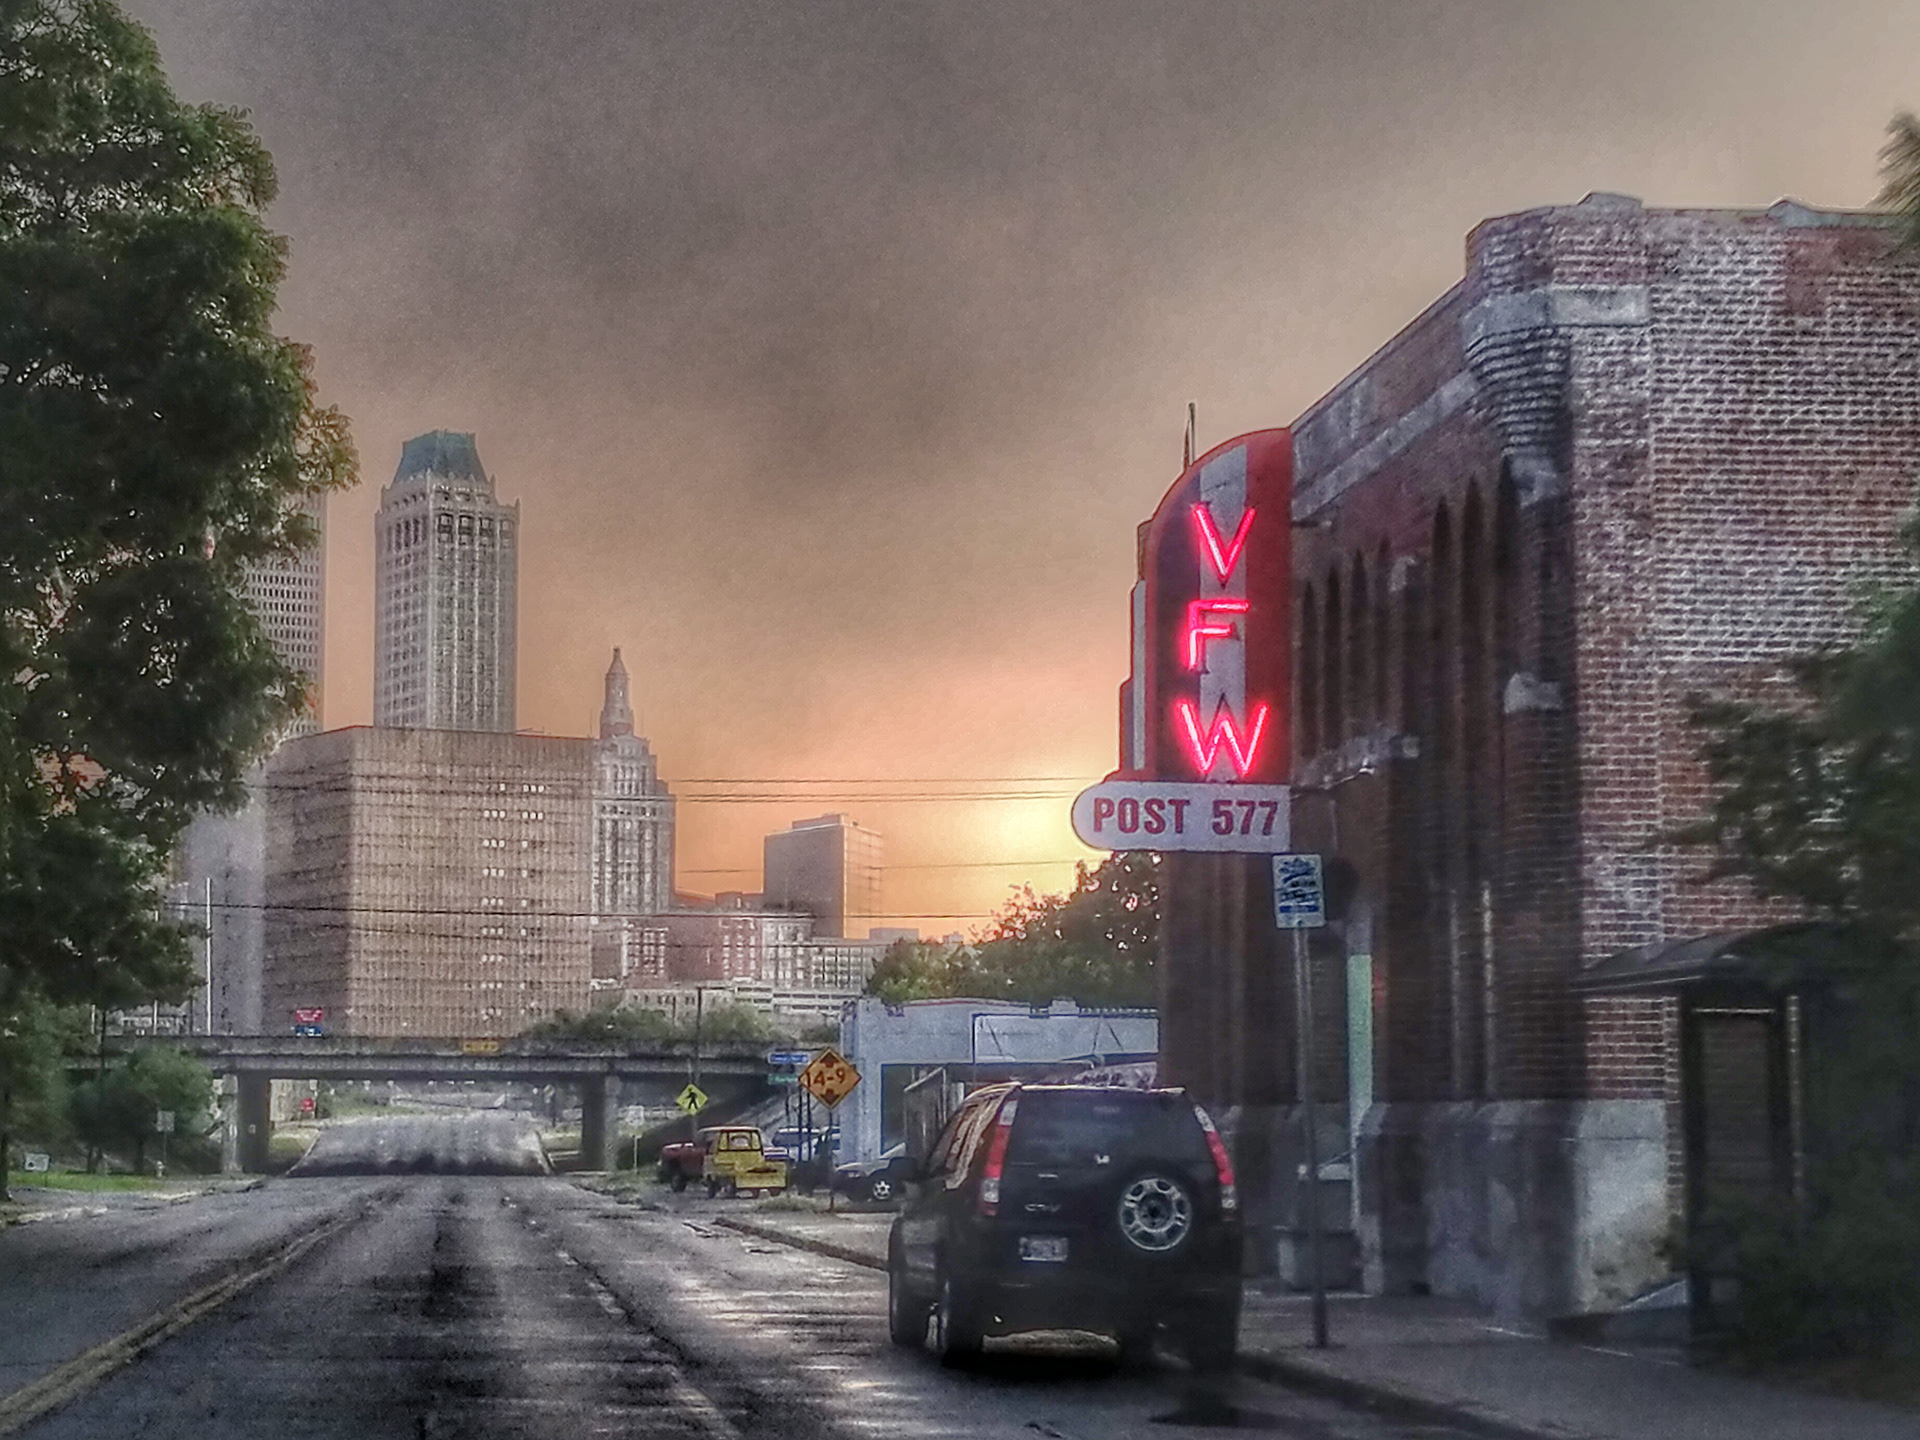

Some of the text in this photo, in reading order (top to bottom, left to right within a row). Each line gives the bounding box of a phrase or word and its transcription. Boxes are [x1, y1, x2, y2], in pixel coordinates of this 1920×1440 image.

[1177, 504, 1270, 776] VFW
[1093, 797, 1278, 836] POST 577
